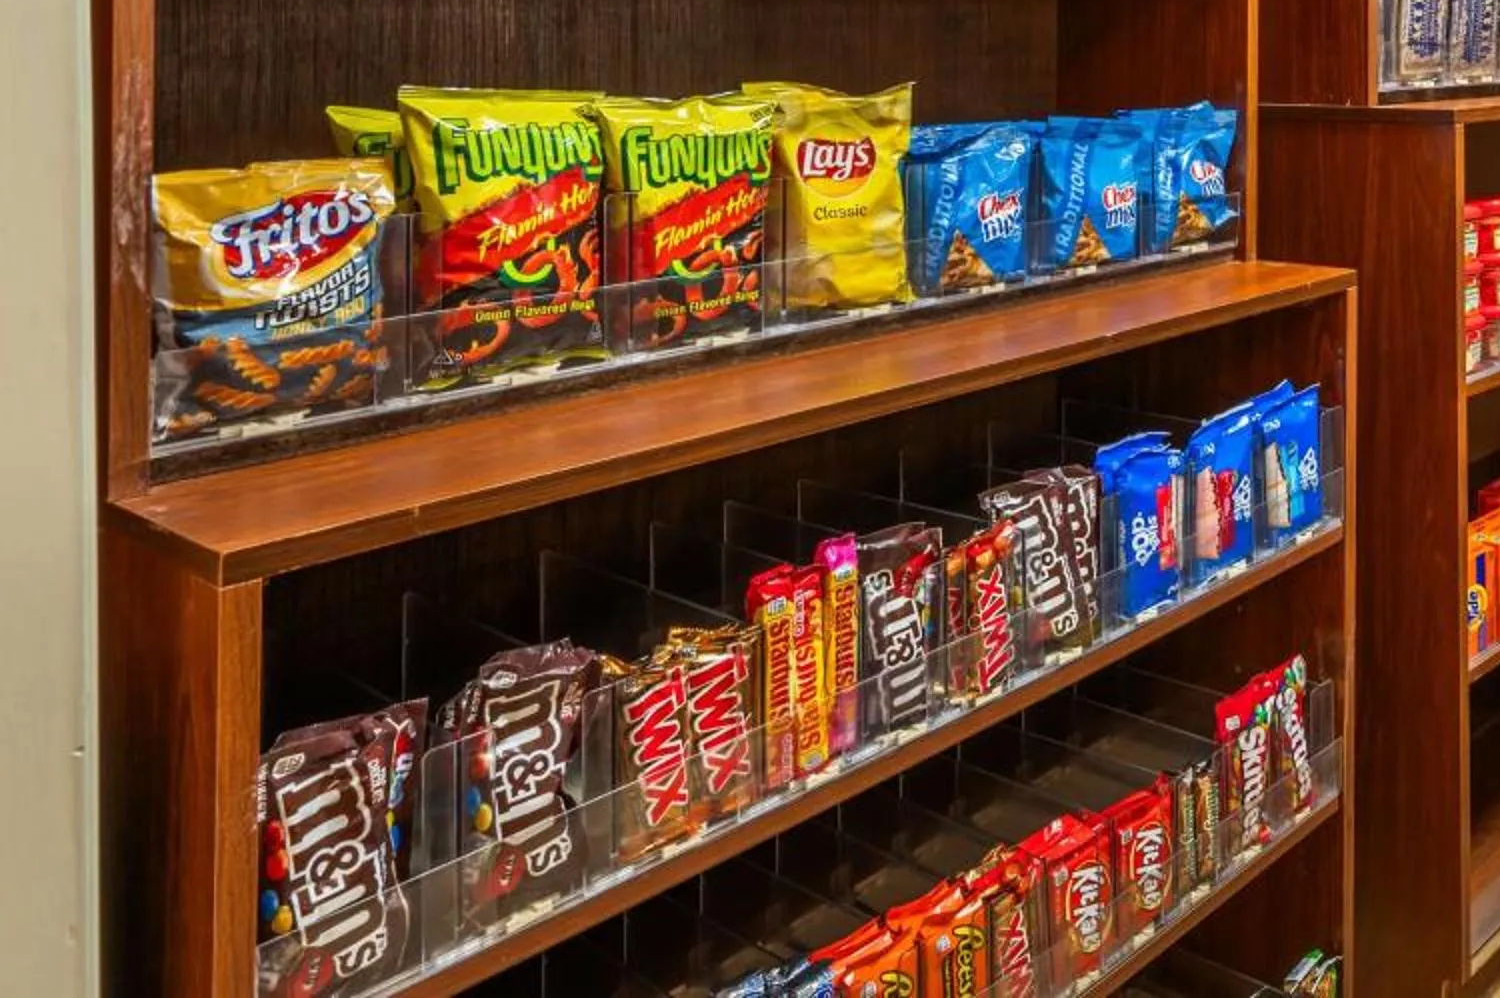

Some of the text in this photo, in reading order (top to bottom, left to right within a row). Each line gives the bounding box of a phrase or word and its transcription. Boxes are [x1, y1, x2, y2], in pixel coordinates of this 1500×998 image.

[801, 137, 872, 181] Lay's
[211, 190, 376, 278] Fritos
[654, 204, 725, 258] Flamin'
[812, 203, 869, 222] Classic
[253, 266, 372, 331] TWISTS
[276, 261, 357, 311] FLAVOR
[515, 302, 567, 318] Flavored
[688, 641, 750, 793] TWIX
[625, 665, 690, 827] TWIX
